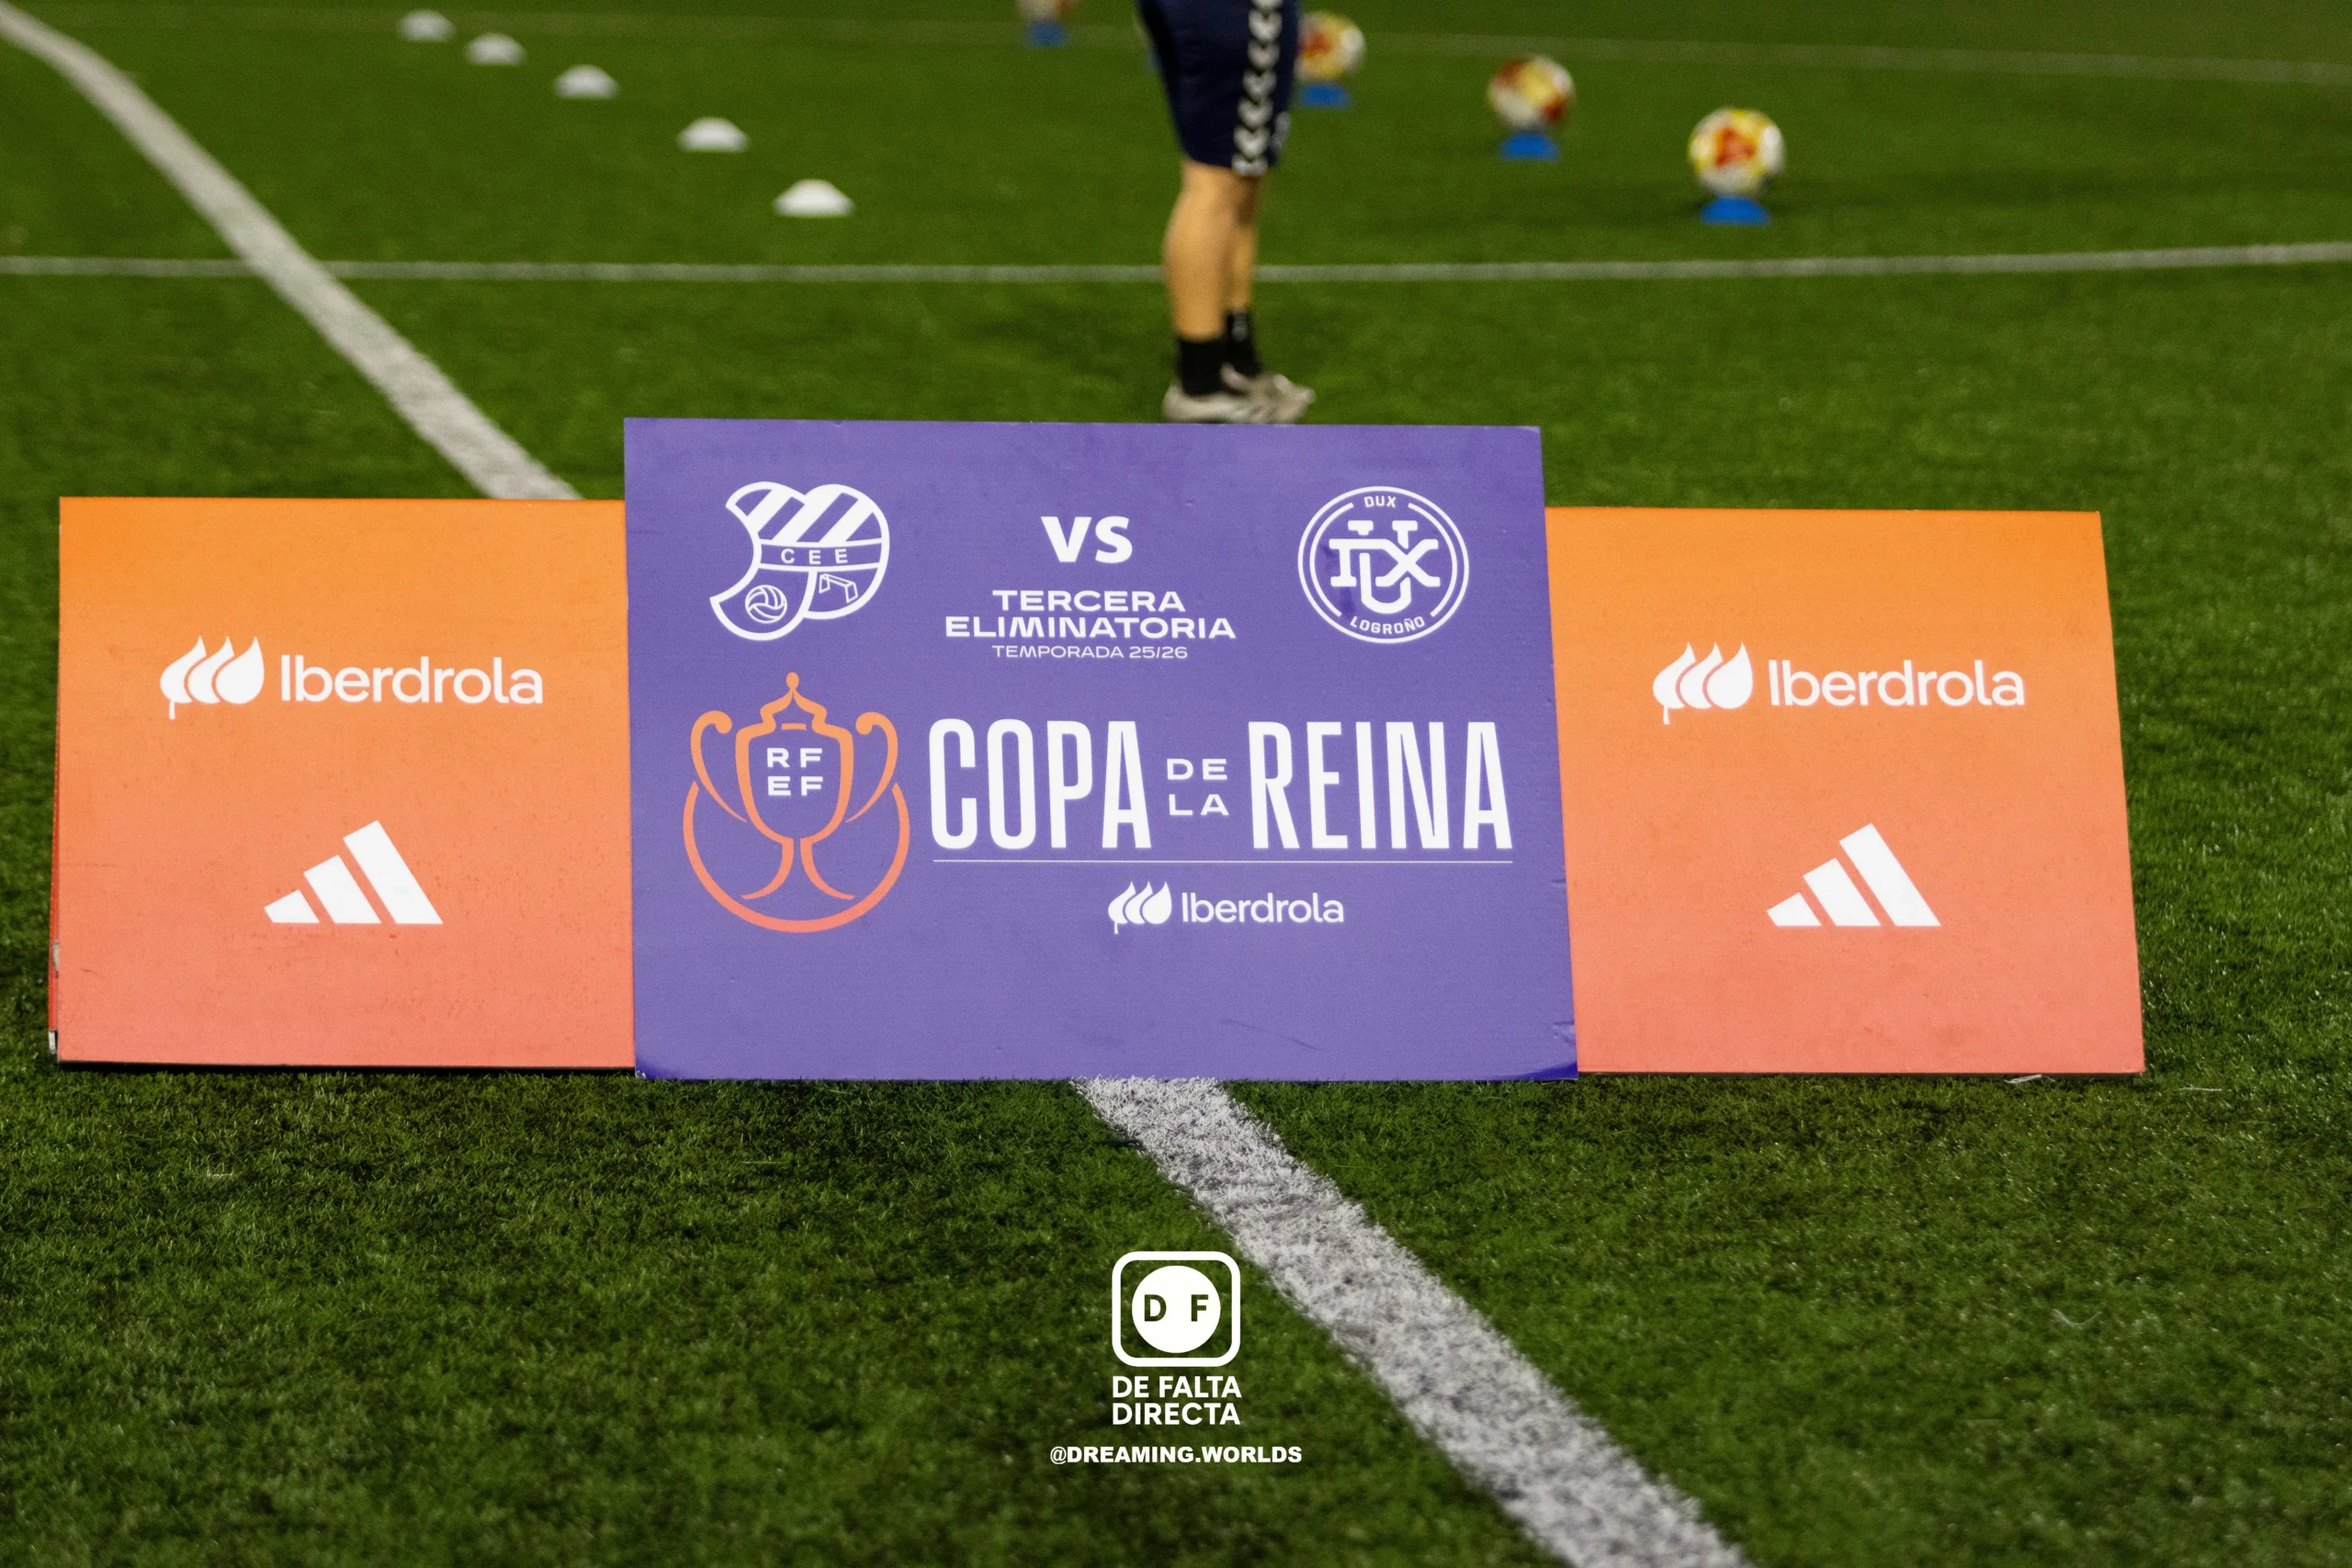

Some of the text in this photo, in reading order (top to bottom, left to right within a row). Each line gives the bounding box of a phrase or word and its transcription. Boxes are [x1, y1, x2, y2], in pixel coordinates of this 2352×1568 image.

[1363, 495, 1396, 508] DUX
[1041, 516, 1132, 563] VS
[992, 591, 1185, 612] TERCERA
[946, 616, 1236, 638] ELIMINATORIA
[1350, 615, 1425, 635] LOGROÑO
[992, 646, 1187, 659] TEMPORADA 25/26
[282, 655, 542, 704] Iberdrola
[1769, 660, 2024, 705] Iberdrola
[767, 748, 822, 767] RF
[768, 776, 823, 795] EF
[929, 718, 1512, 850] COPA DE LA REINA
[1182, 893, 1343, 922] Iberdrola
